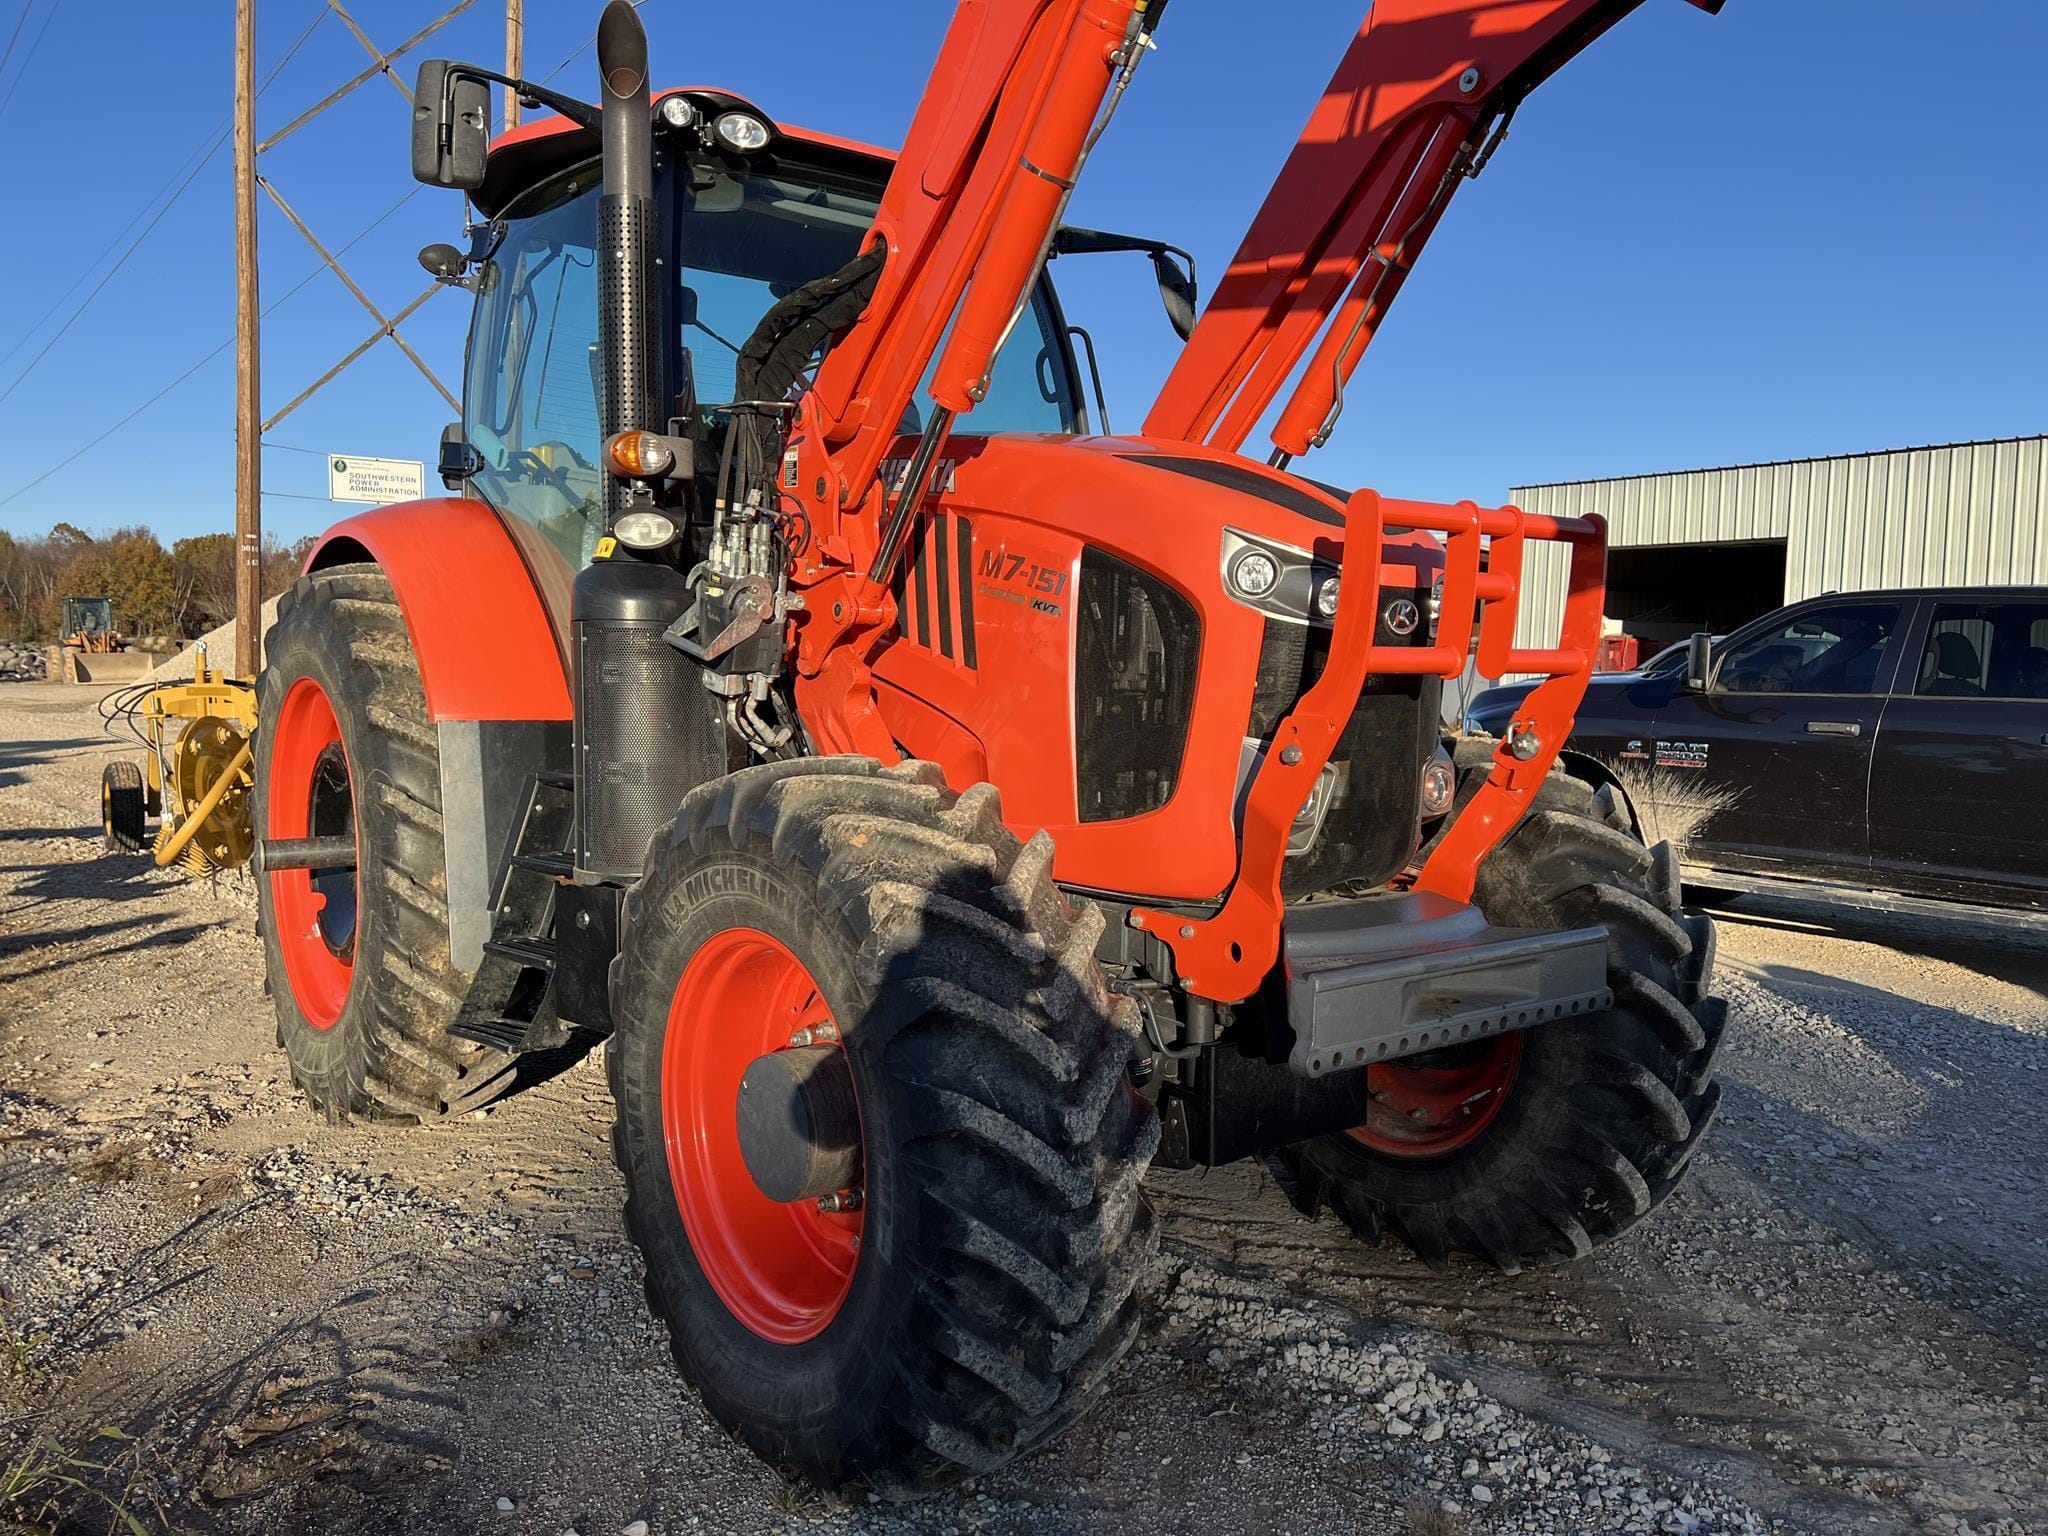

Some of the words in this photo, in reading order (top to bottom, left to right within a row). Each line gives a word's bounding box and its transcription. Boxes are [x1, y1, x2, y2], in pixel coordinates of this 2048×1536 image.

[349, 472, 417, 484] SOUTHWESTERN
[880, 459, 955, 493] UBTA
[349, 479, 380, 487] POWER
[349, 485, 419, 496] ADMINISTRATION
[978, 549, 1067, 597] M7-151
[1033, 600, 1059, 614] KVT
[1656, 740, 1709, 753] RAM
[685, 867, 787, 908] MICHELIN
